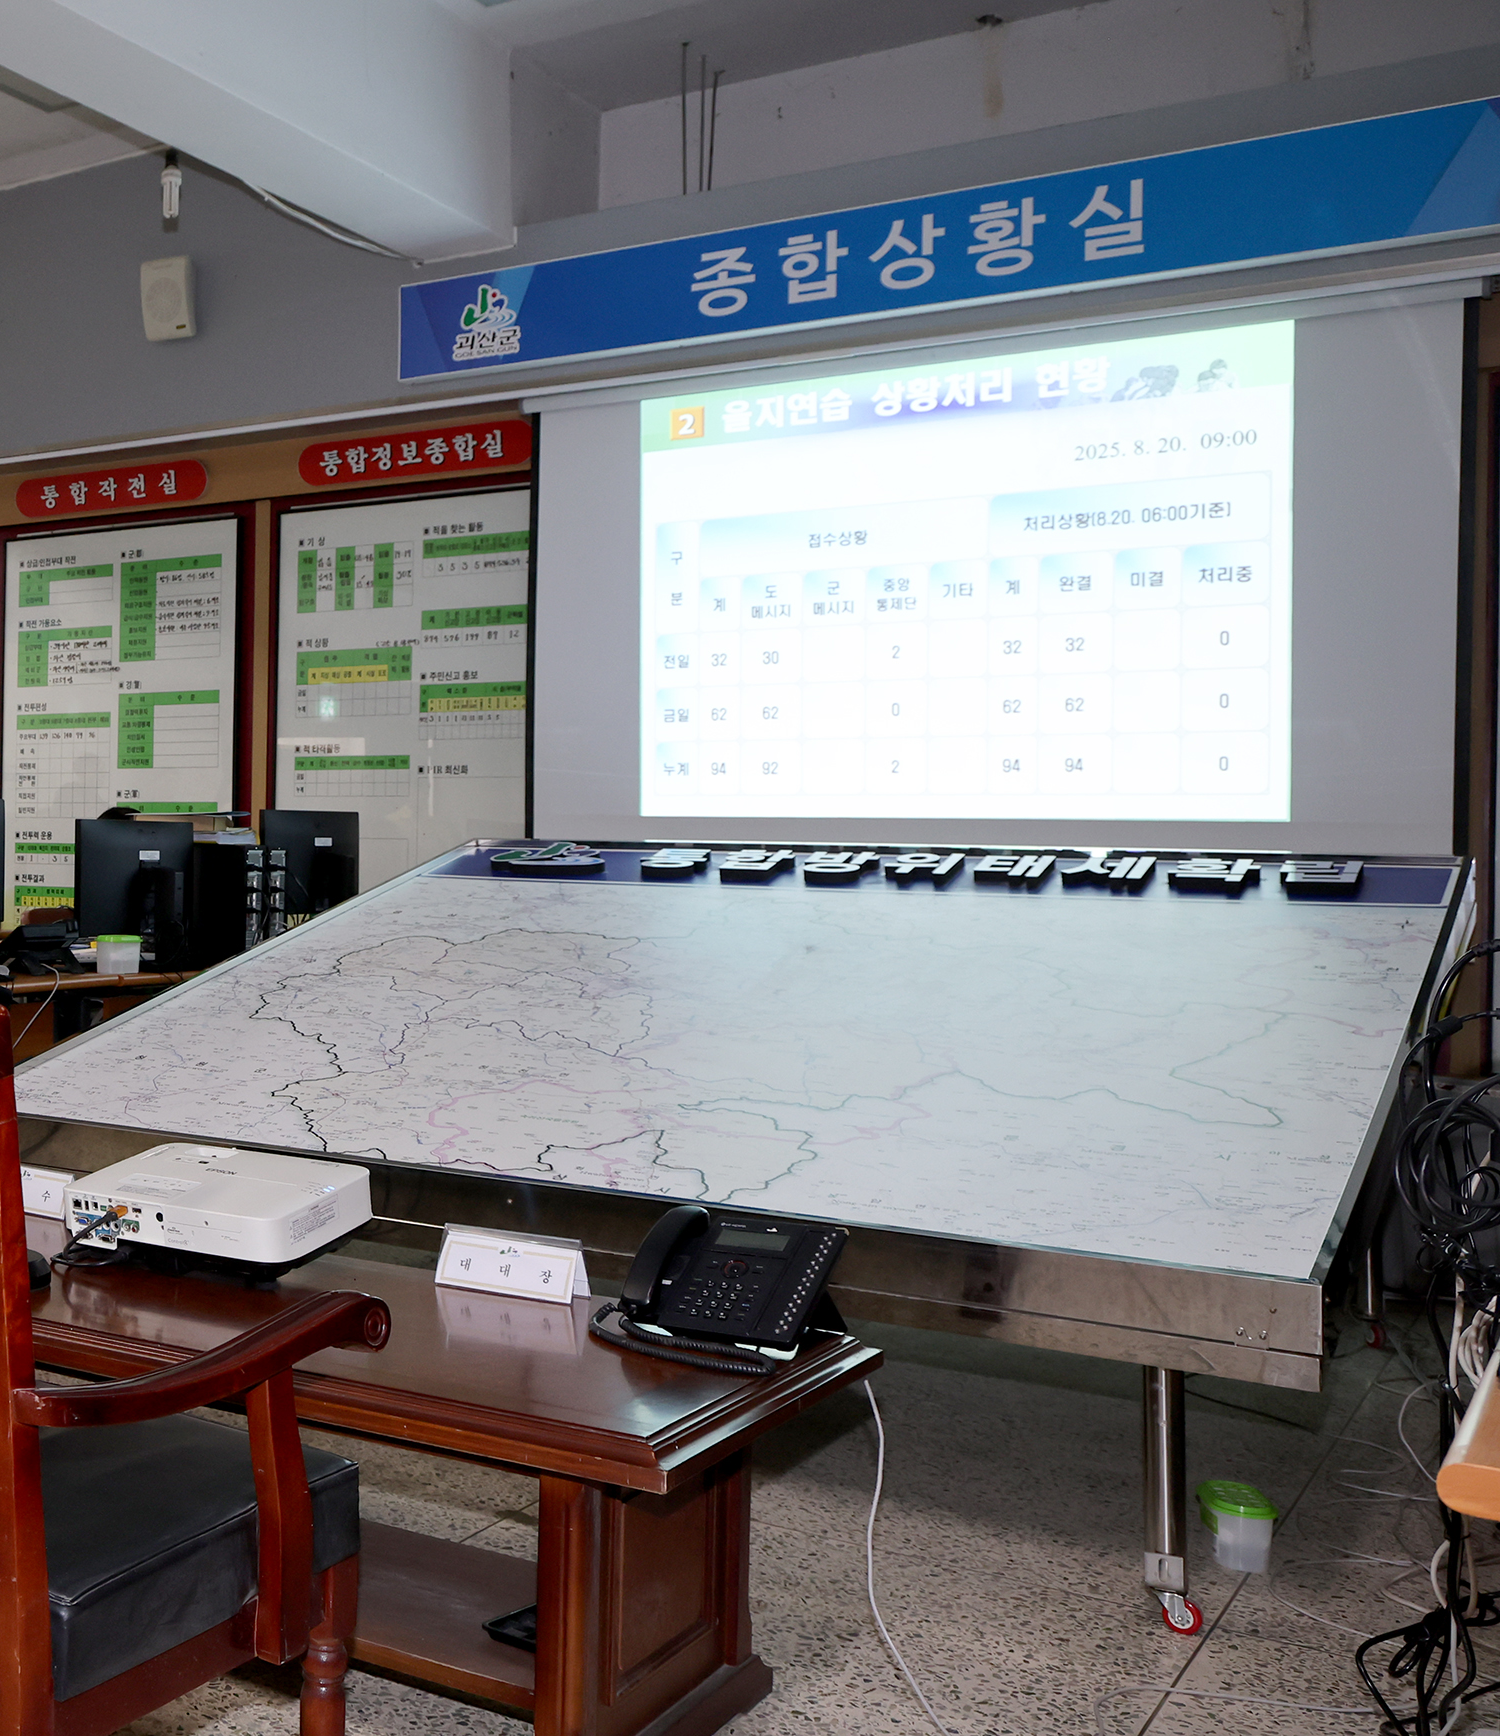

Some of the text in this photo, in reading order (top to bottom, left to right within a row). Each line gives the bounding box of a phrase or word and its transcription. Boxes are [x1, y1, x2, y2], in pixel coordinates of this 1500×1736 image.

[691, 178, 1144, 317] 종합상황실
[456, 329, 518, 349] 괴산군
[496, 345, 517, 353] GUN
[677, 356, 1110, 436] 2 을지연습 상황처리 현황
[319, 429, 505, 477] 통합정보종합실
[1074, 429, 1258, 462] 2025. 8. 20. 09:00
[41, 470, 178, 509] 통합작전실
[1141, 502, 1231, 525] 06:00기준)
[808, 530, 868, 549] 접수상황
[1130, 571, 1164, 587] 미결
[1198, 565, 1253, 584] 처리중
[827, 581, 840, 596] 군
[883, 578, 910, 593] 중앙
[943, 582, 974, 598] 기타
[1005, 580, 1021, 595] 계
[1059, 575, 1092, 592] 완결
[765, 585, 778, 599] 도
[713, 598, 726, 612] 계
[751, 604, 792, 619] 메시지
[813, 600, 855, 616] 메시지
[876, 597, 917, 612] 통제단
[1065, 637, 1085, 652] 32
[1219, 630, 1230, 646] 0
[891, 645, 901, 659] 2
[1002, 640, 1022, 655] 32
[664, 654, 690, 669] 전일
[711, 653, 728, 667] 32
[762, 651, 779, 665] 30
[1002, 699, 1022, 714] 62
[1065, 697, 1084, 712] 62
[1219, 693, 1230, 709] 0
[664, 708, 690, 723] 금일
[711, 708, 728, 721] 62
[762, 706, 779, 720] 62
[891, 703, 900, 717] 0
[664, 762, 690, 776] 누계
[711, 762, 727, 776] 94
[762, 761, 779, 775] 92
[891, 760, 901, 774] 2
[1002, 758, 1021, 773] 94
[1065, 757, 1084, 773] 94
[1219, 756, 1229, 771] 0
[640, 847, 1364, 887] 통합방위태세확립
[205, 1167, 239, 1176] EPSON
[460, 1257, 553, 1284] 대대장
